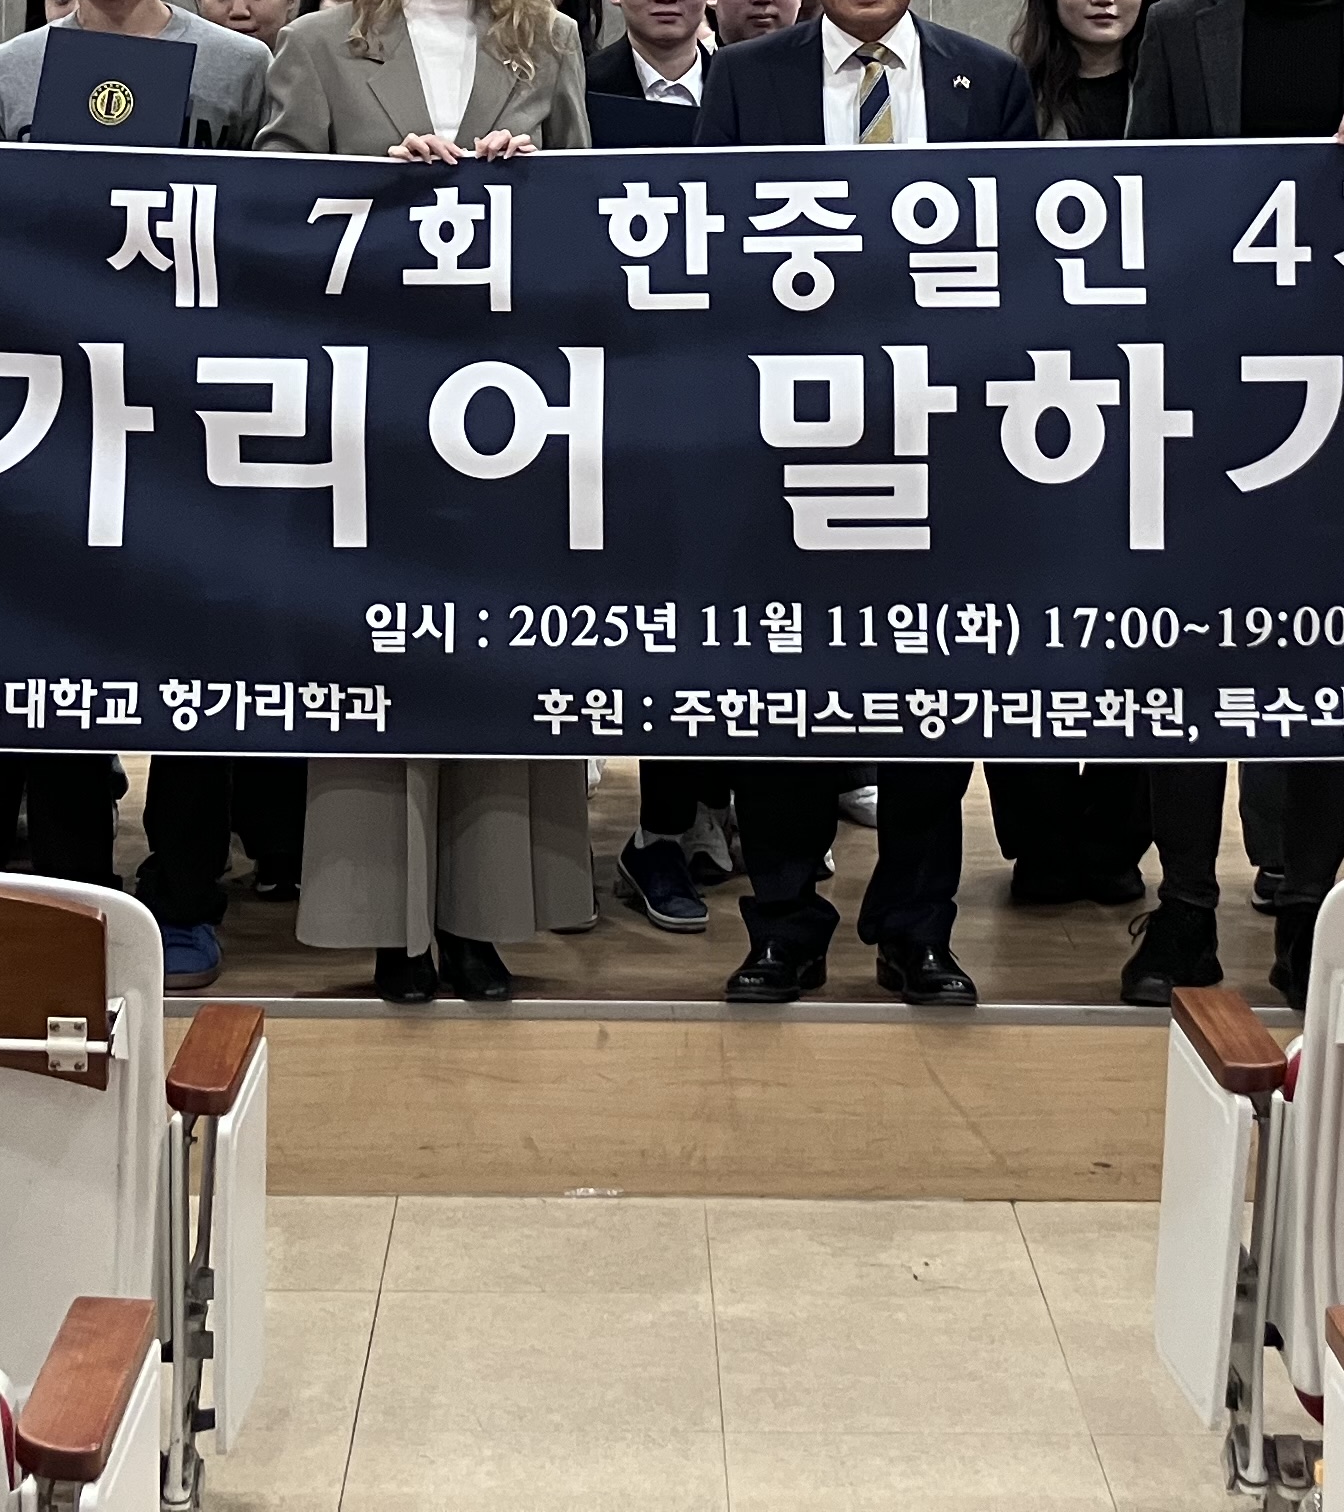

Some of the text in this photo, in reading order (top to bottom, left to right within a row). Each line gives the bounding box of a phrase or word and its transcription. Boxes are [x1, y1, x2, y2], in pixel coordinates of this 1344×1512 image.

[107, 183, 218, 307] 제
[307, 185, 511, 311] 7회
[599, 176, 1146, 311] 한중일인
[366, 603, 454, 653] 일시
[509, 603, 676, 652] 2025년
[702, 602, 802, 653] 11월
[828, 603, 1019, 655] 11일(화)
[159, 679, 391, 731] 헝가리학과
[534, 689, 622, 735] 후원
[671, 688, 1198, 741] 주한리스트헝가리문화원,
